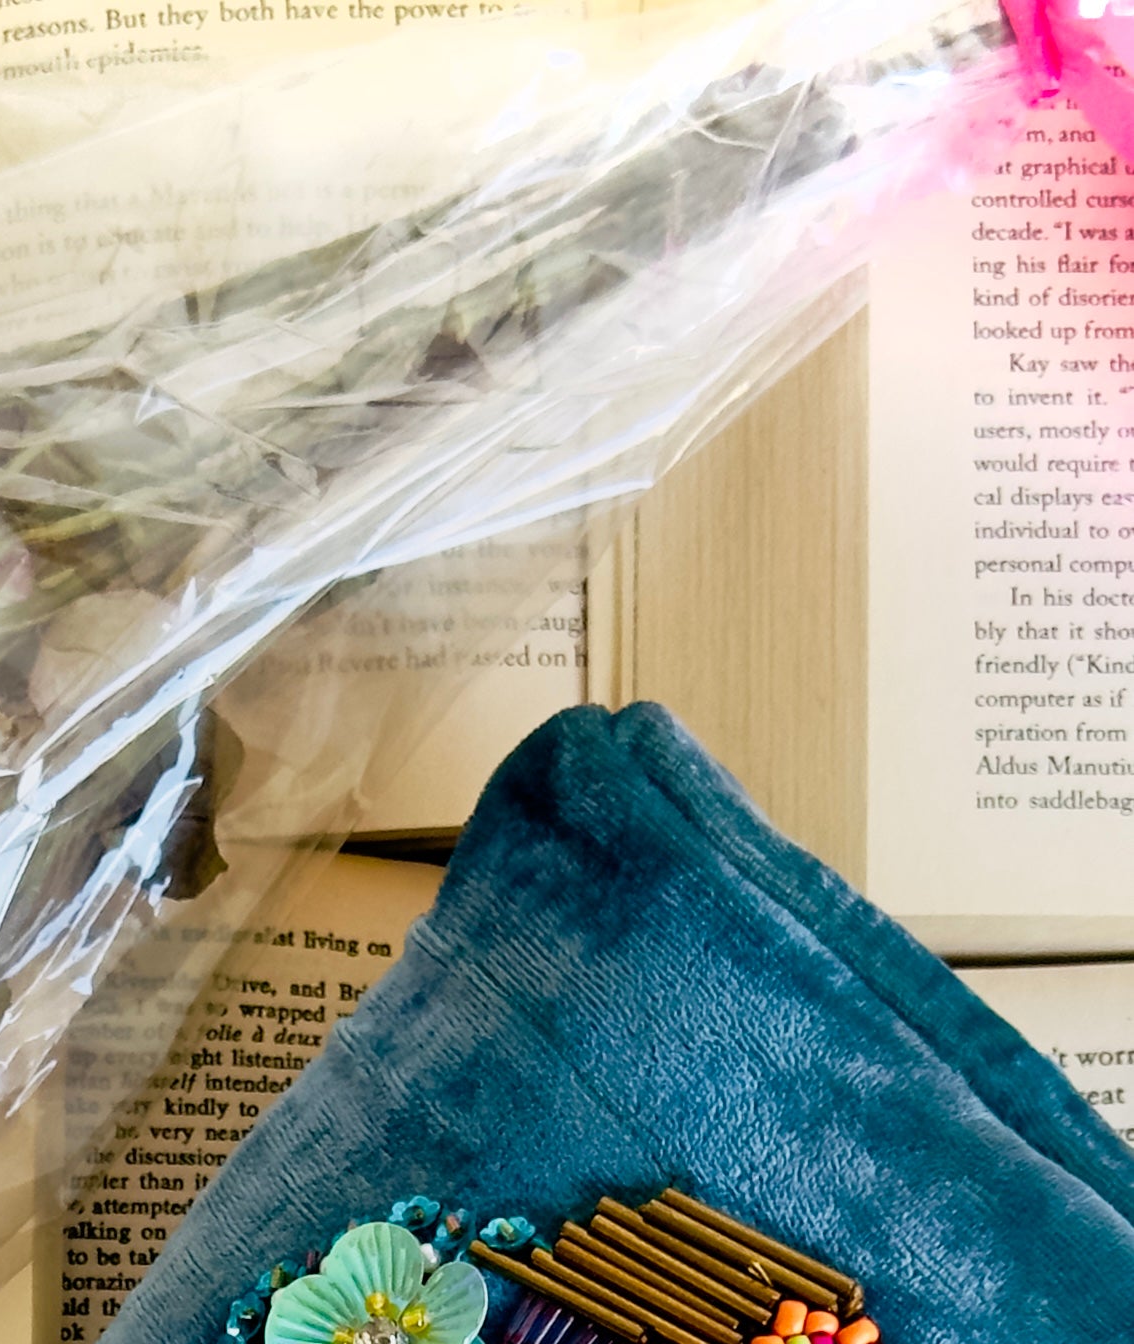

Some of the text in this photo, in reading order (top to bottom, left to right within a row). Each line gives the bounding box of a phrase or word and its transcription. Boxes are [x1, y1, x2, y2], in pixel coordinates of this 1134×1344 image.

[2, 18, 95, 44] reasons.
[105, 8, 147, 31] But
[157, 2, 209, 31] they
[219, 0, 275, 23] both
[284, 0, 339, 21] have
[348, 0, 385, 20] the
[393, 3, 470, 27] power
[972, 319, 1078, 346] looked up
[973, 387, 1108, 406] to invent it.
[974, 552, 1062, 580] personal
[1010, 585, 1073, 607] In his
[974, 653, 1060, 681] friendly
[974, 687, 1128, 715] computer as if
[975, 754, 1039, 776] Aldus
[976, 791, 1019, 810] into
[303, 929, 392, 958] living on
[238, 1003, 326, 1026] wrapped
[273, 1026, 323, 1048] deux
[163, 1096, 260, 1121] kindly to
